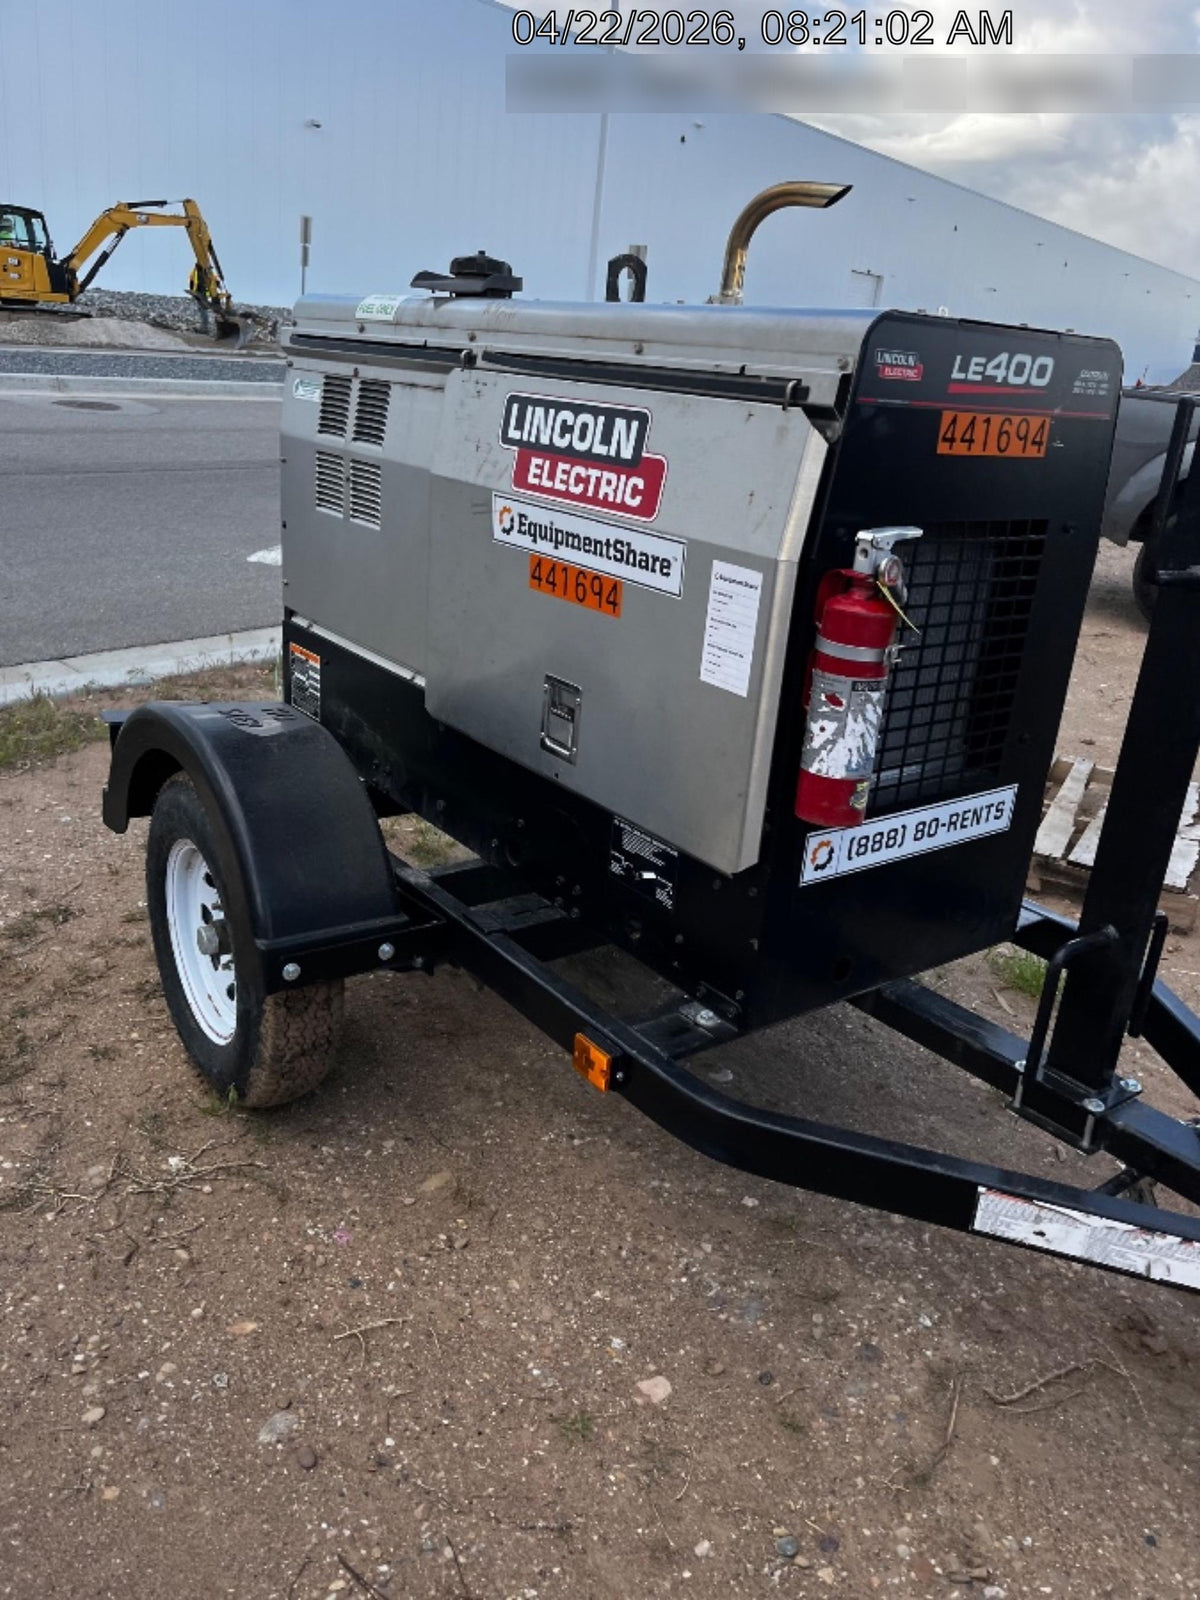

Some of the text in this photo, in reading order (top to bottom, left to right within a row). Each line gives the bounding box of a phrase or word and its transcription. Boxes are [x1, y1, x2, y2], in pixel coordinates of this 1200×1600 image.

[950, 351, 1055, 387] LE400
[507, 402, 639, 460] LINCOLN
[941, 413, 1047, 454] 441694
[527, 456, 645, 508] ELECTRIC
[516, 512, 672, 578] EquipmentShare
[530, 557, 619, 614] 441694
[847, 800, 1006, 861] (888) 80-RENTS
